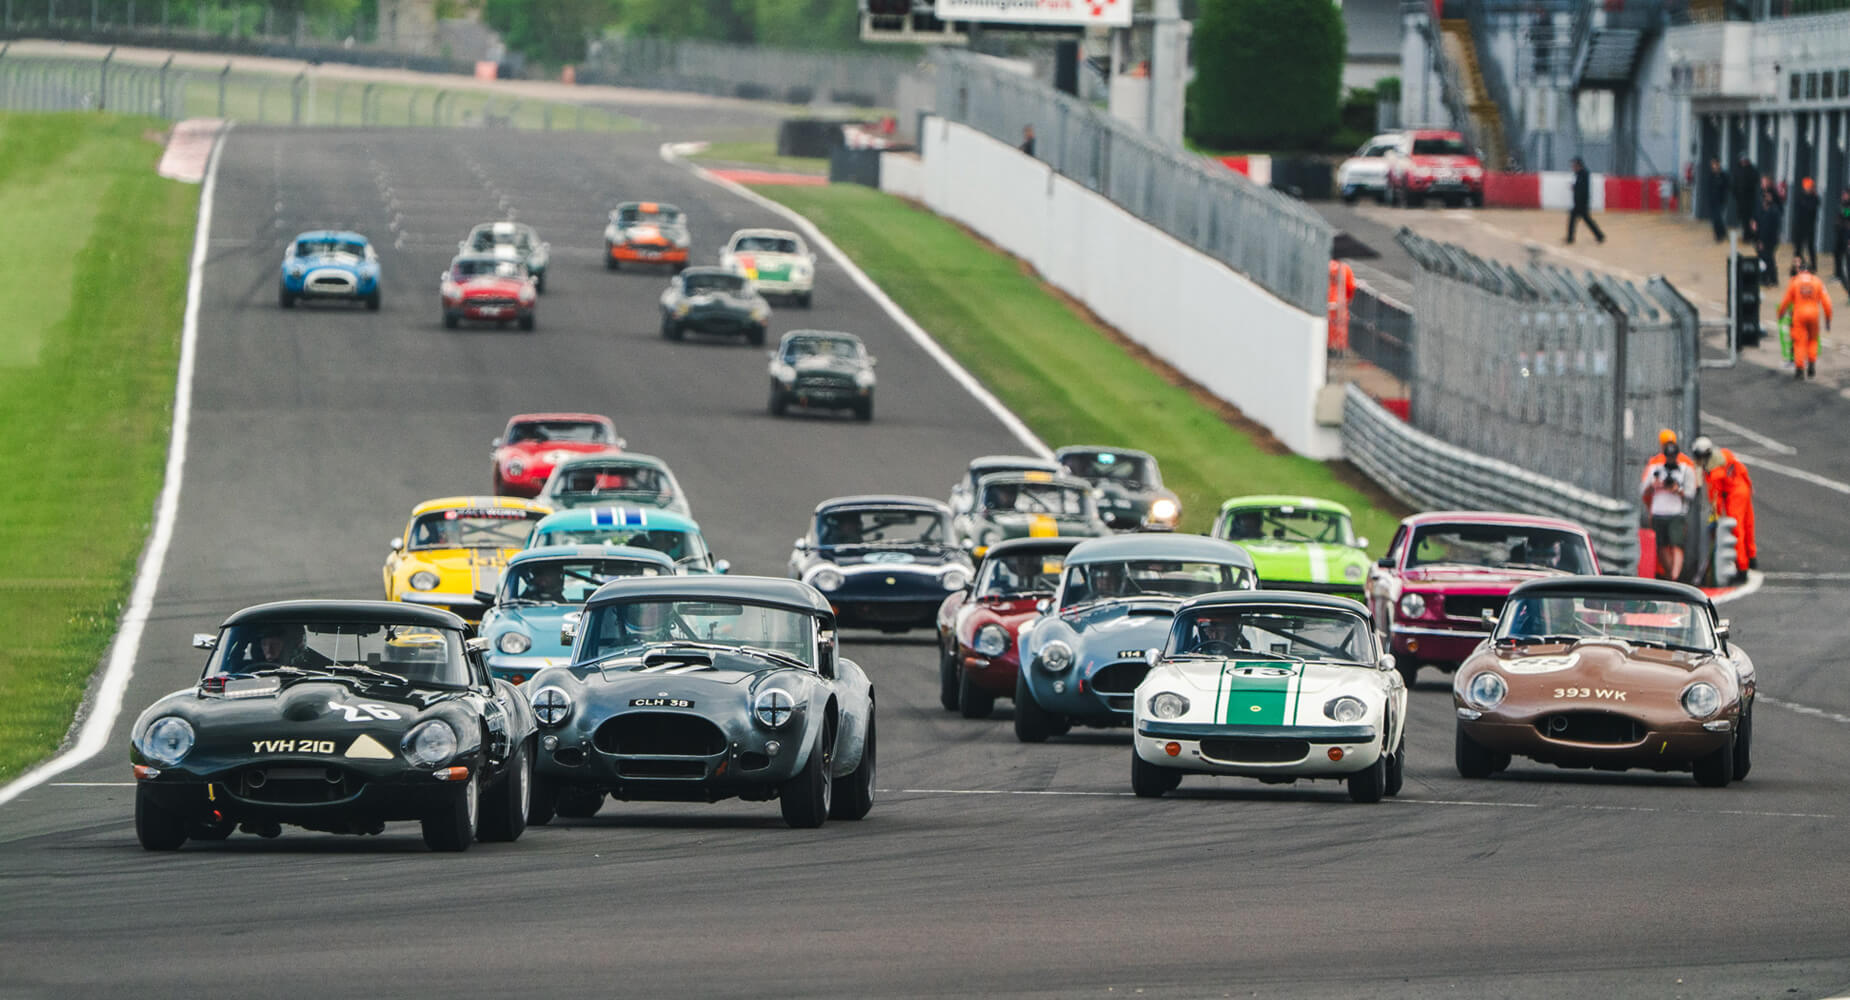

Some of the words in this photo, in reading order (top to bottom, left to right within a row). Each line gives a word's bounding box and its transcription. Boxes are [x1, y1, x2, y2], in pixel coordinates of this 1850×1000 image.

[1553, 688, 1591, 699] 393
[1595, 688, 1627, 701] WK
[328, 701, 401, 721] 26
[252, 740, 296, 753] YVH
[298, 740, 335, 753] 210
